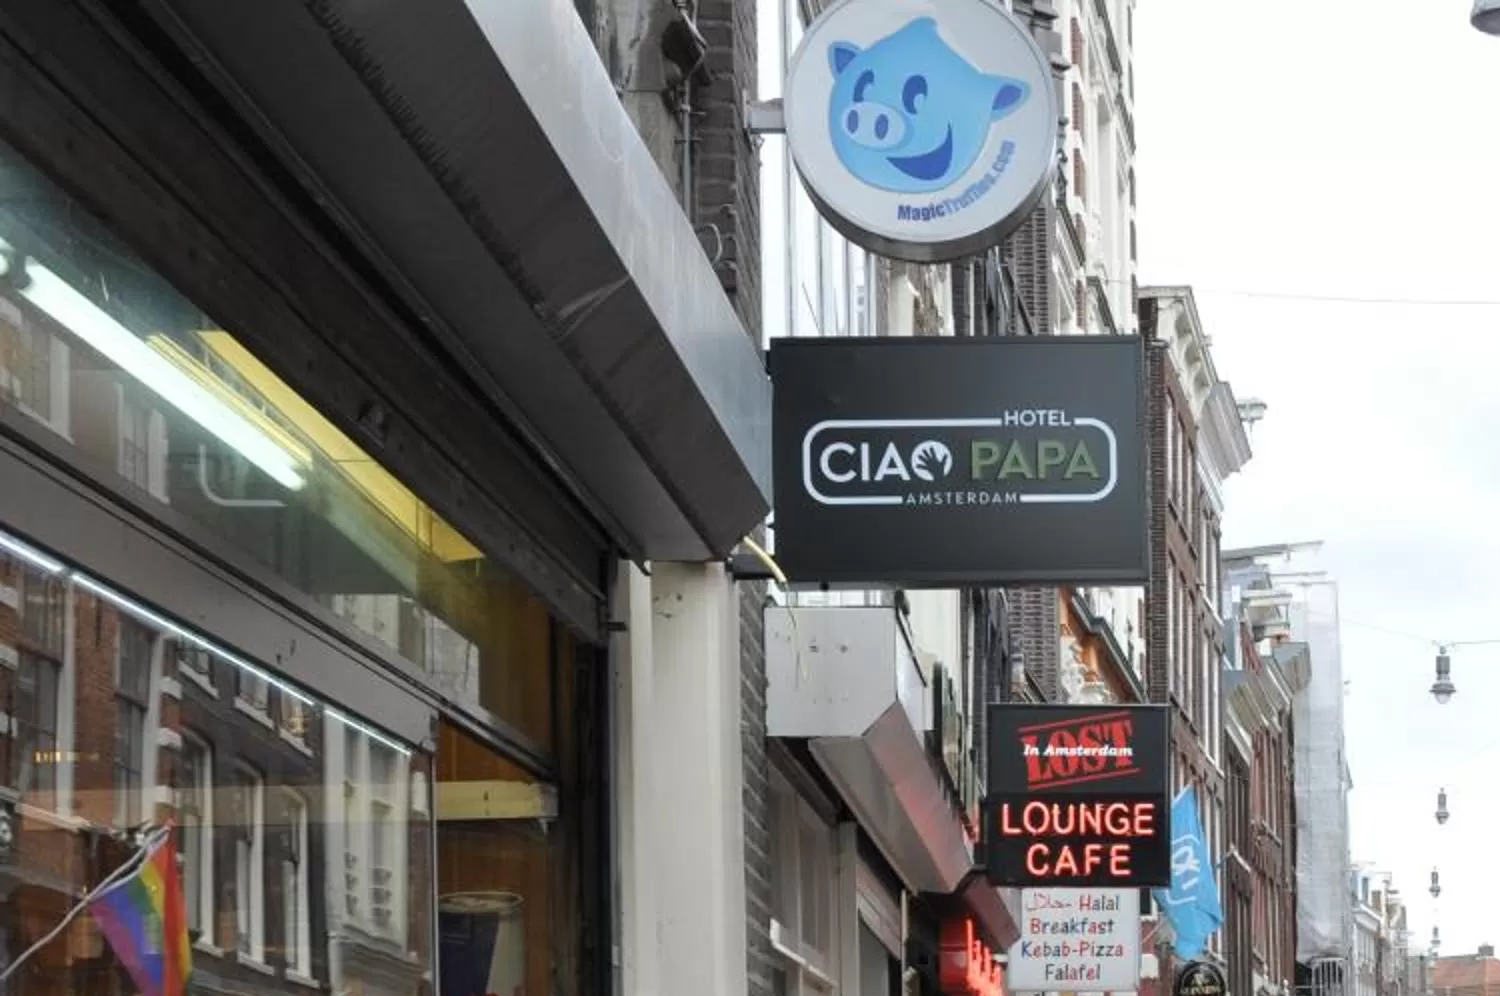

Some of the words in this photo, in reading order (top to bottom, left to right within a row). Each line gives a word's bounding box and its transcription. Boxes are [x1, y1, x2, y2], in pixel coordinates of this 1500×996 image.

[1004, 410, 1071, 426] HOTEL
[820, 440, 953, 482] CIAO
[971, 440, 1100, 480] PAPA
[906, 492, 1019, 505] AMSTERDAM
[1020, 719, 1134, 783] LOST
[1024, 744, 1040, 757] In
[1044, 744, 1133, 757] Amsterdam
[1002, 801, 1155, 836] LOUNGE
[1026, 843, 1132, 877] CAFE
[1079, 893, 1120, 911] Halal
[1030, 917, 1115, 935] Breakfast
[1021, 940, 1124, 958] Kebab-Pizza
[1045, 963, 1101, 981] Falafel
